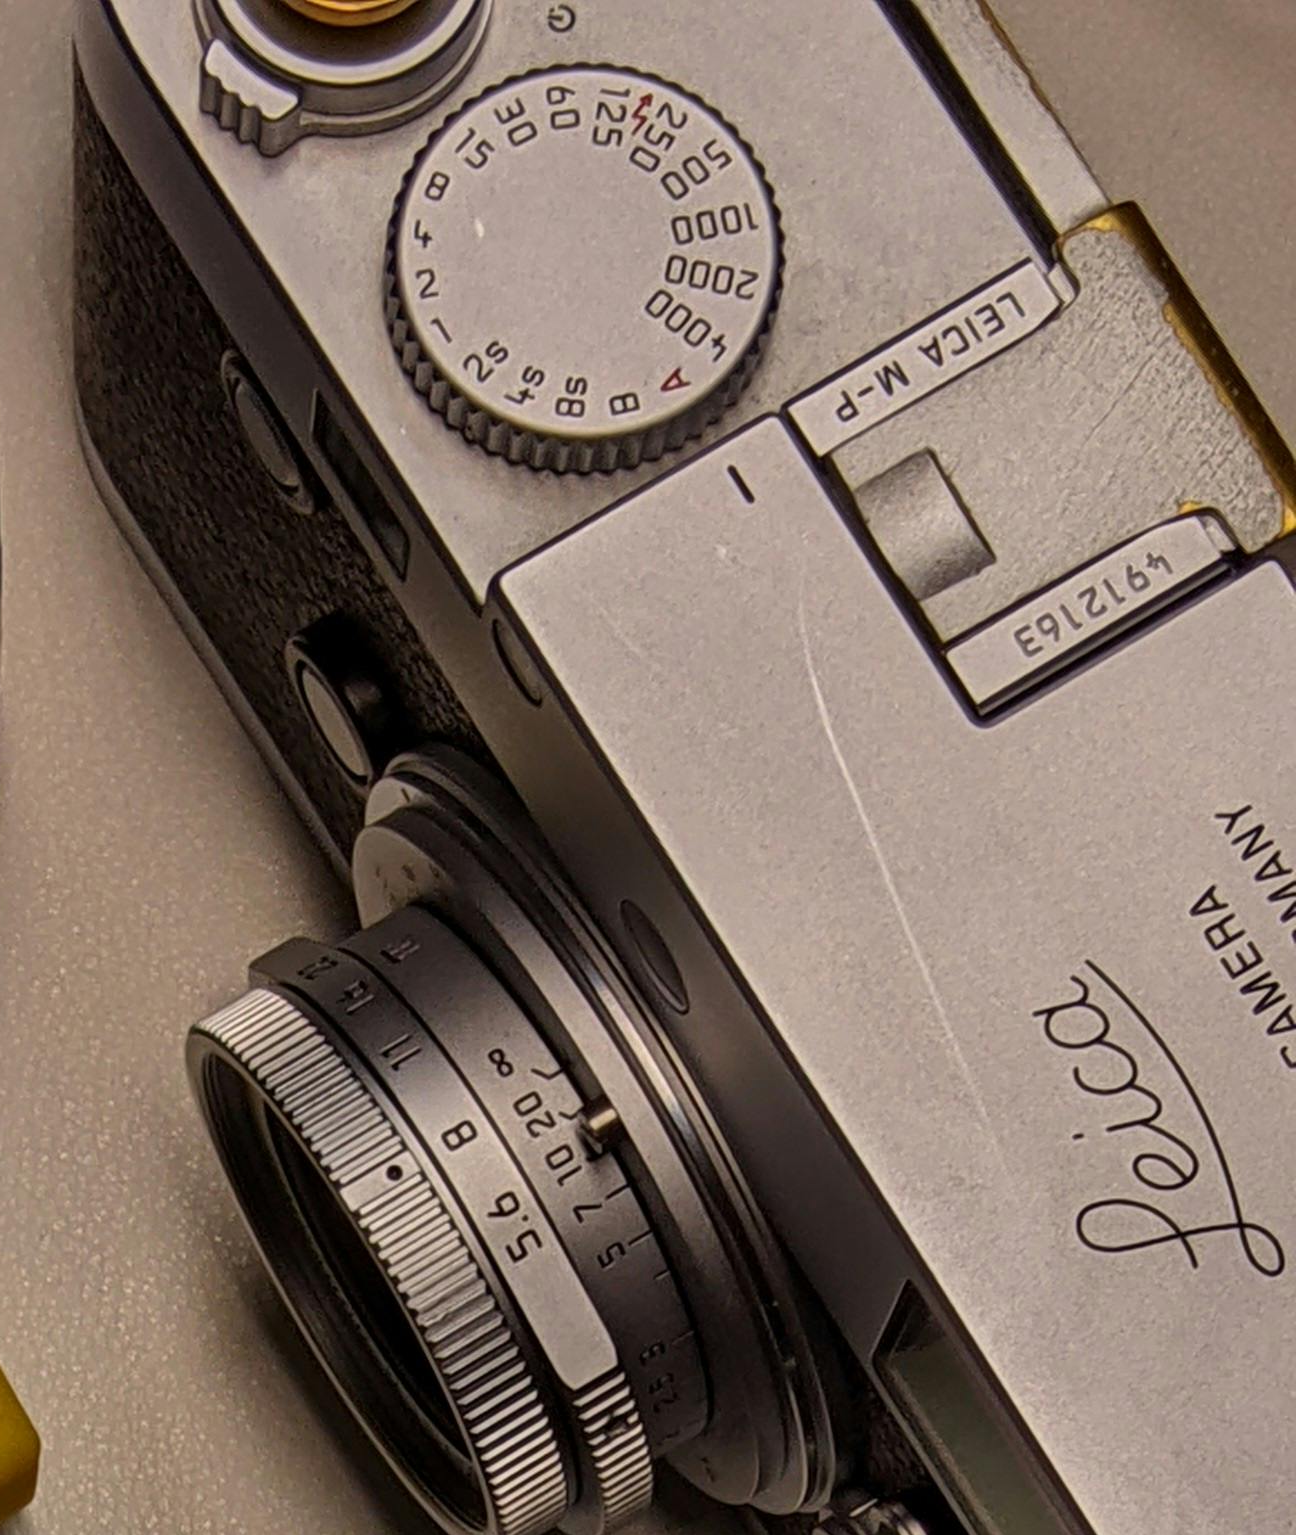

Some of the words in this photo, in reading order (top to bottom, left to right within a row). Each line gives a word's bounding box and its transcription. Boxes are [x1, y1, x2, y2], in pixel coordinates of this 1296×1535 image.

[494, 97, 539, 148] 30
[545, 86, 581, 131] 60
[592, 87, 632, 149] 125
[453, 127, 496, 171] 15
[629, 102, 689, 173] 250
[423, 171, 451, 201] 8
[661, 138, 733, 201] 500
[412, 219, 434, 249] 4
[670, 201, 760, 246] 1000
[415, 267, 440, 300] 2
[663, 253, 760, 302] 2000
[429, 317, 454, 345] 1
[643, 289, 730, 363] 4000
[916, 290, 1027, 369] LEICA
[609, 391, 641, 417] B
[659, 367, 692, 394] A
[835, 358, 911, 424] M-P
[1012, 549, 1174, 660] 4912163
[1213, 804, 1296, 940] MANY
[1032, 958, 1285, 1278] Leica
[440, 1119, 478, 1154] 8
[485, 1190, 545, 1265] 5.6
[512, 1089, 559, 1140] 20
[543, 1145, 584, 1188] 10
[572, 1201, 604, 1225] 7
[596, 1240, 627, 1271] 5
